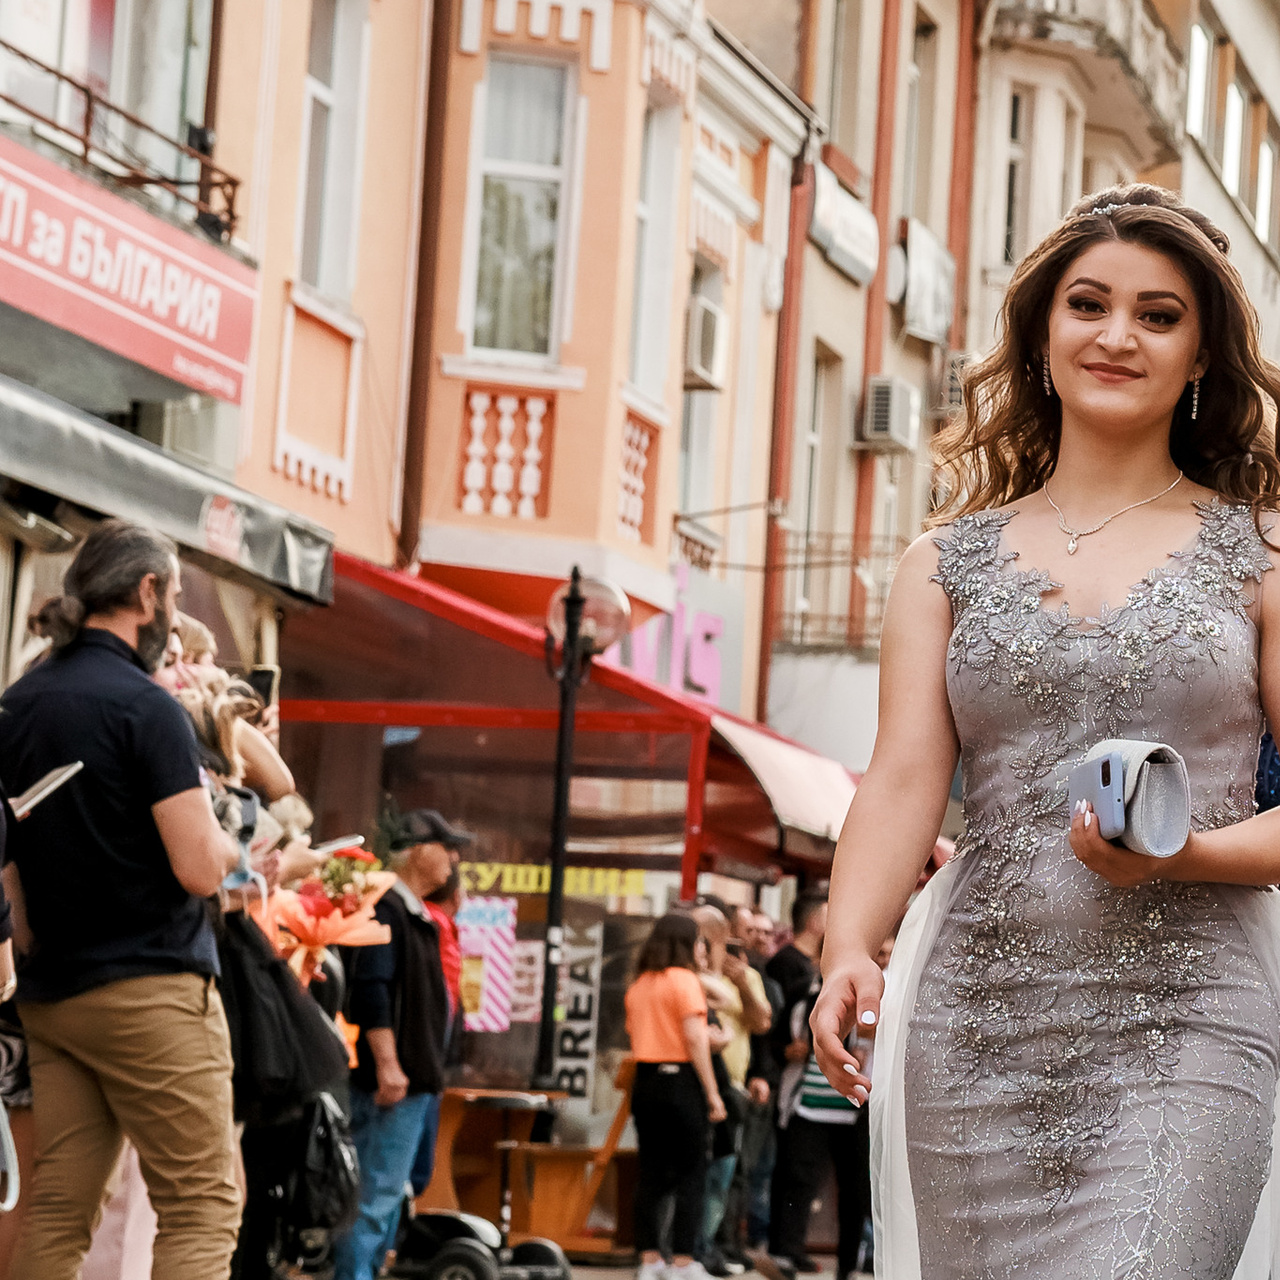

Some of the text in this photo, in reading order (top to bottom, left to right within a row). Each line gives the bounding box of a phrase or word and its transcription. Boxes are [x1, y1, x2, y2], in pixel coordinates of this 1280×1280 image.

[28, 210, 66, 267] за
[68, 216, 222, 342] БЪЛГАРИЯ
[557, 922, 600, 1098] BREAK
